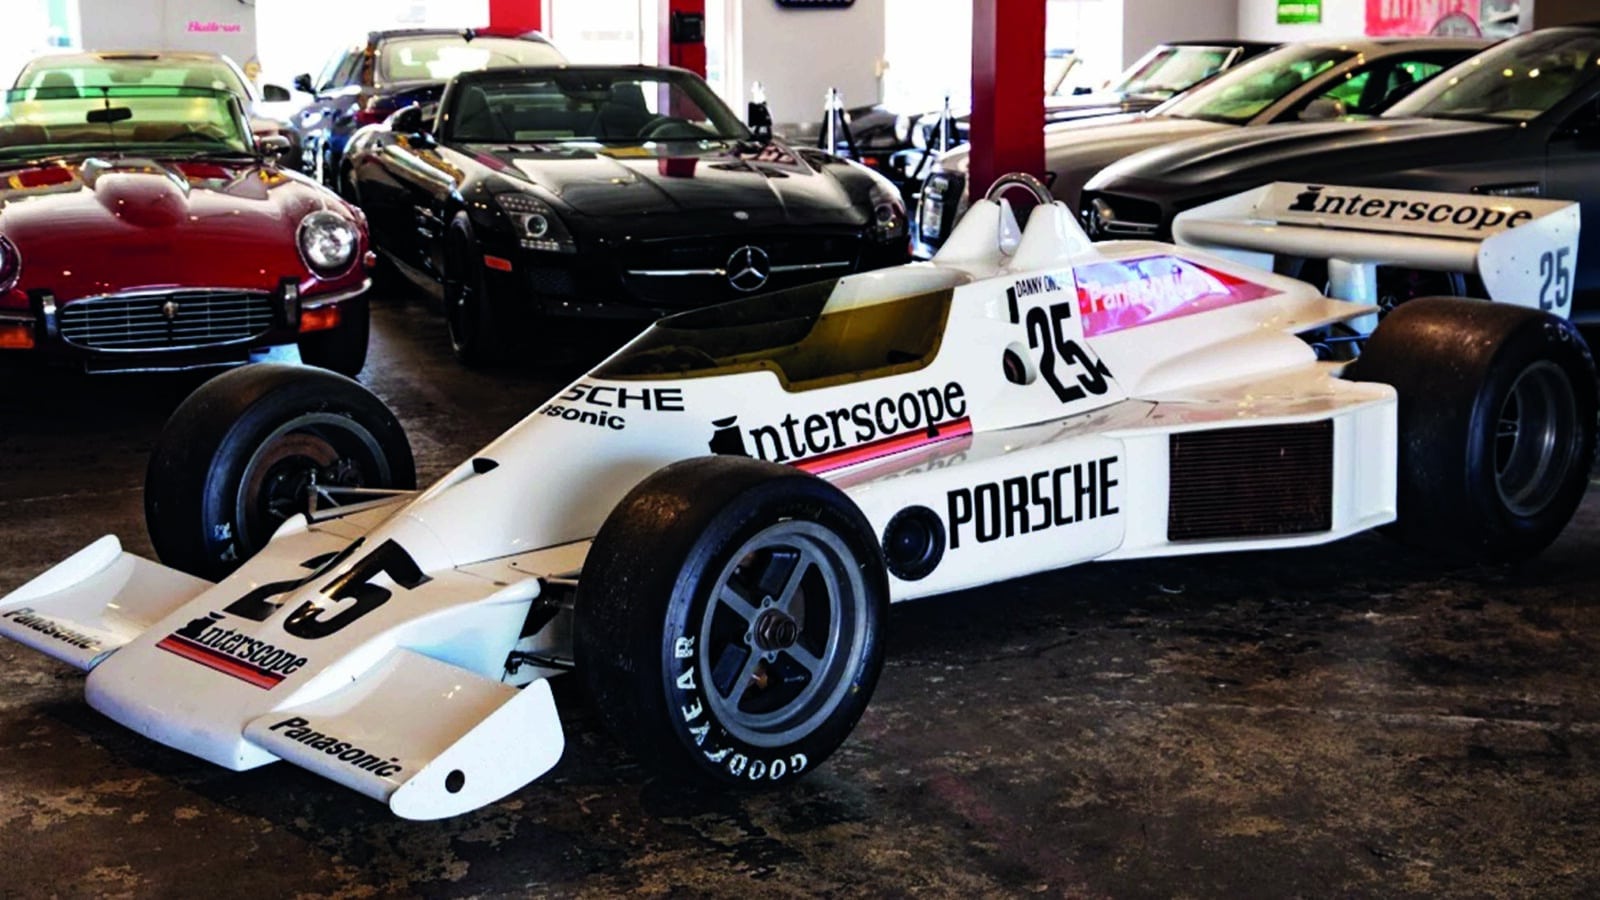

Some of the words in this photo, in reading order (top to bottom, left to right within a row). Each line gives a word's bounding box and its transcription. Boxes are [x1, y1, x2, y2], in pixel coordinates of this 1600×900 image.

[1288, 186, 1532, 230] Interscope
[1016, 276, 1043, 298] DANNY
[1539, 247, 1569, 311] 25
[1026, 302, 1112, 403] 25
[708, 381, 966, 464] Interscope
[947, 456, 1120, 549] PORSCHE
[222, 536, 434, 640] 25
[2, 608, 102, 649] Panasonic
[174, 611, 308, 675] Interscope
[269, 716, 403, 777] Panasonic
